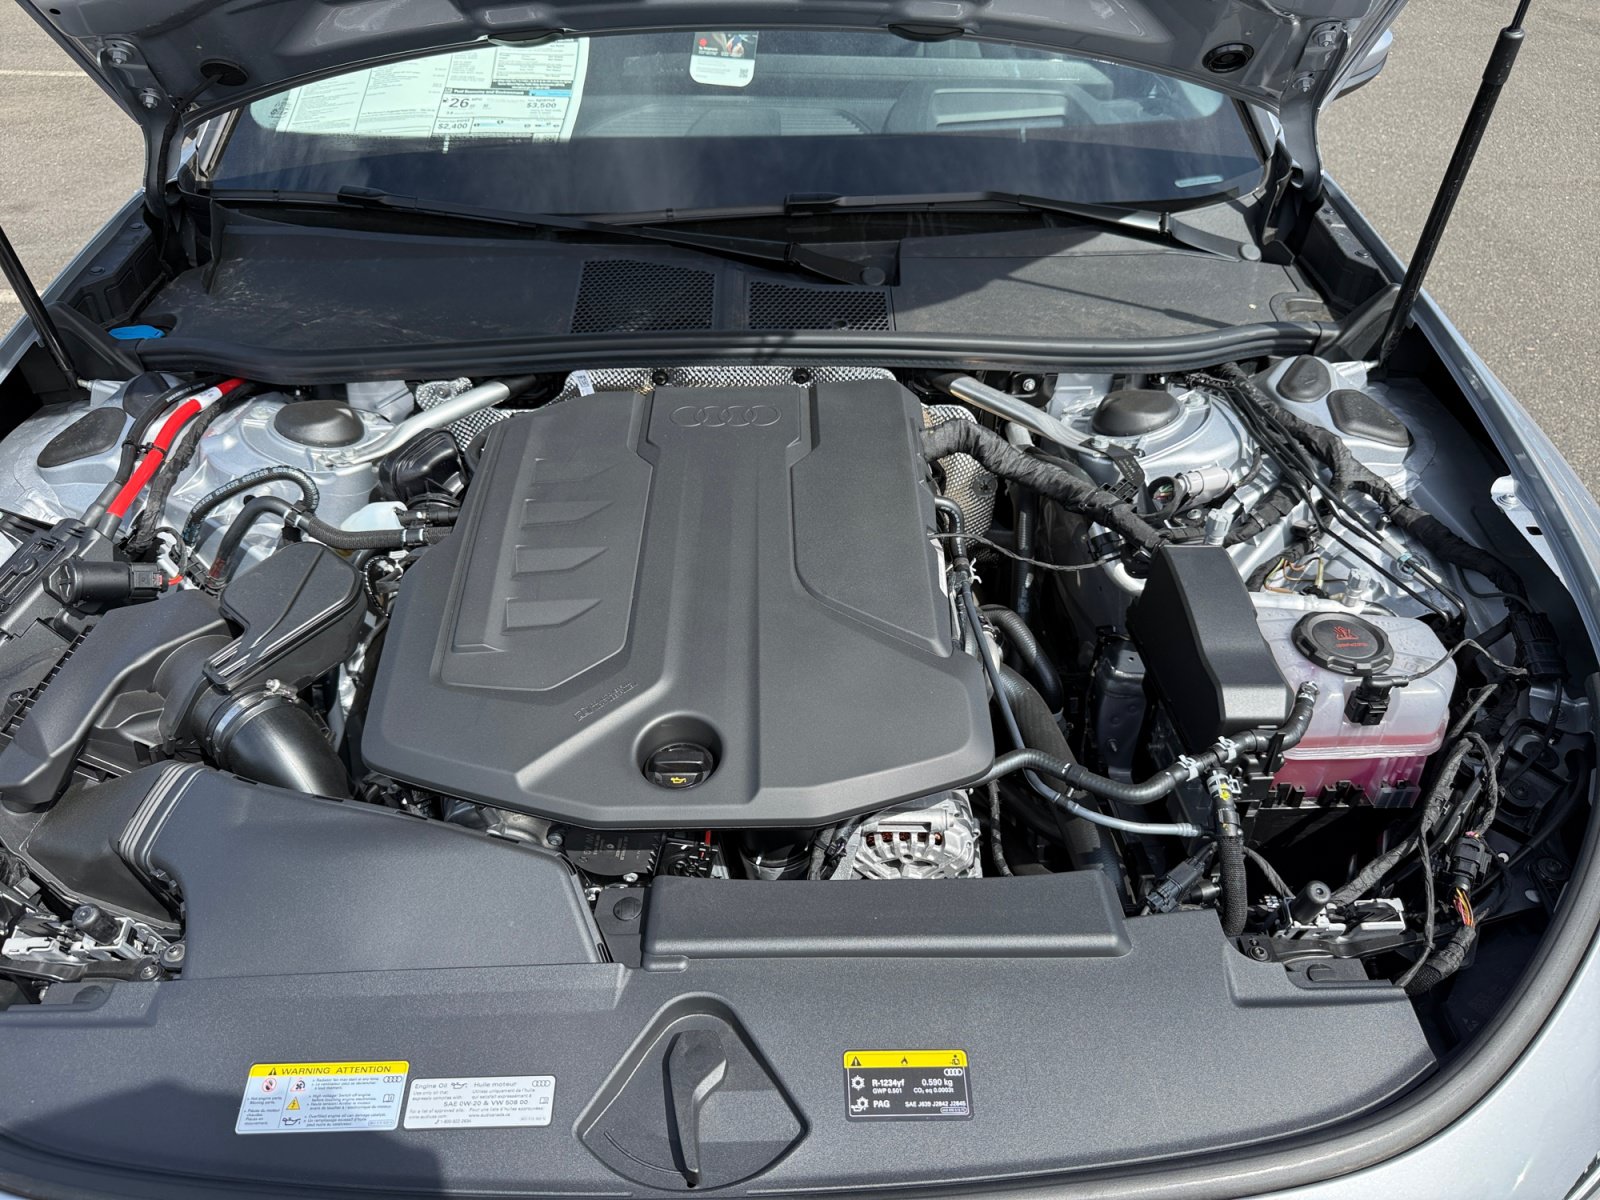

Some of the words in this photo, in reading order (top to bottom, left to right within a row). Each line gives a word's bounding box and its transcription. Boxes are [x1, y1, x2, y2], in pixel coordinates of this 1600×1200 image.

[449, 98, 470, 108] 26
[336, 1066, 391, 1074] ATTENTION
[872, 1079, 904, 1087] R-1234yf
